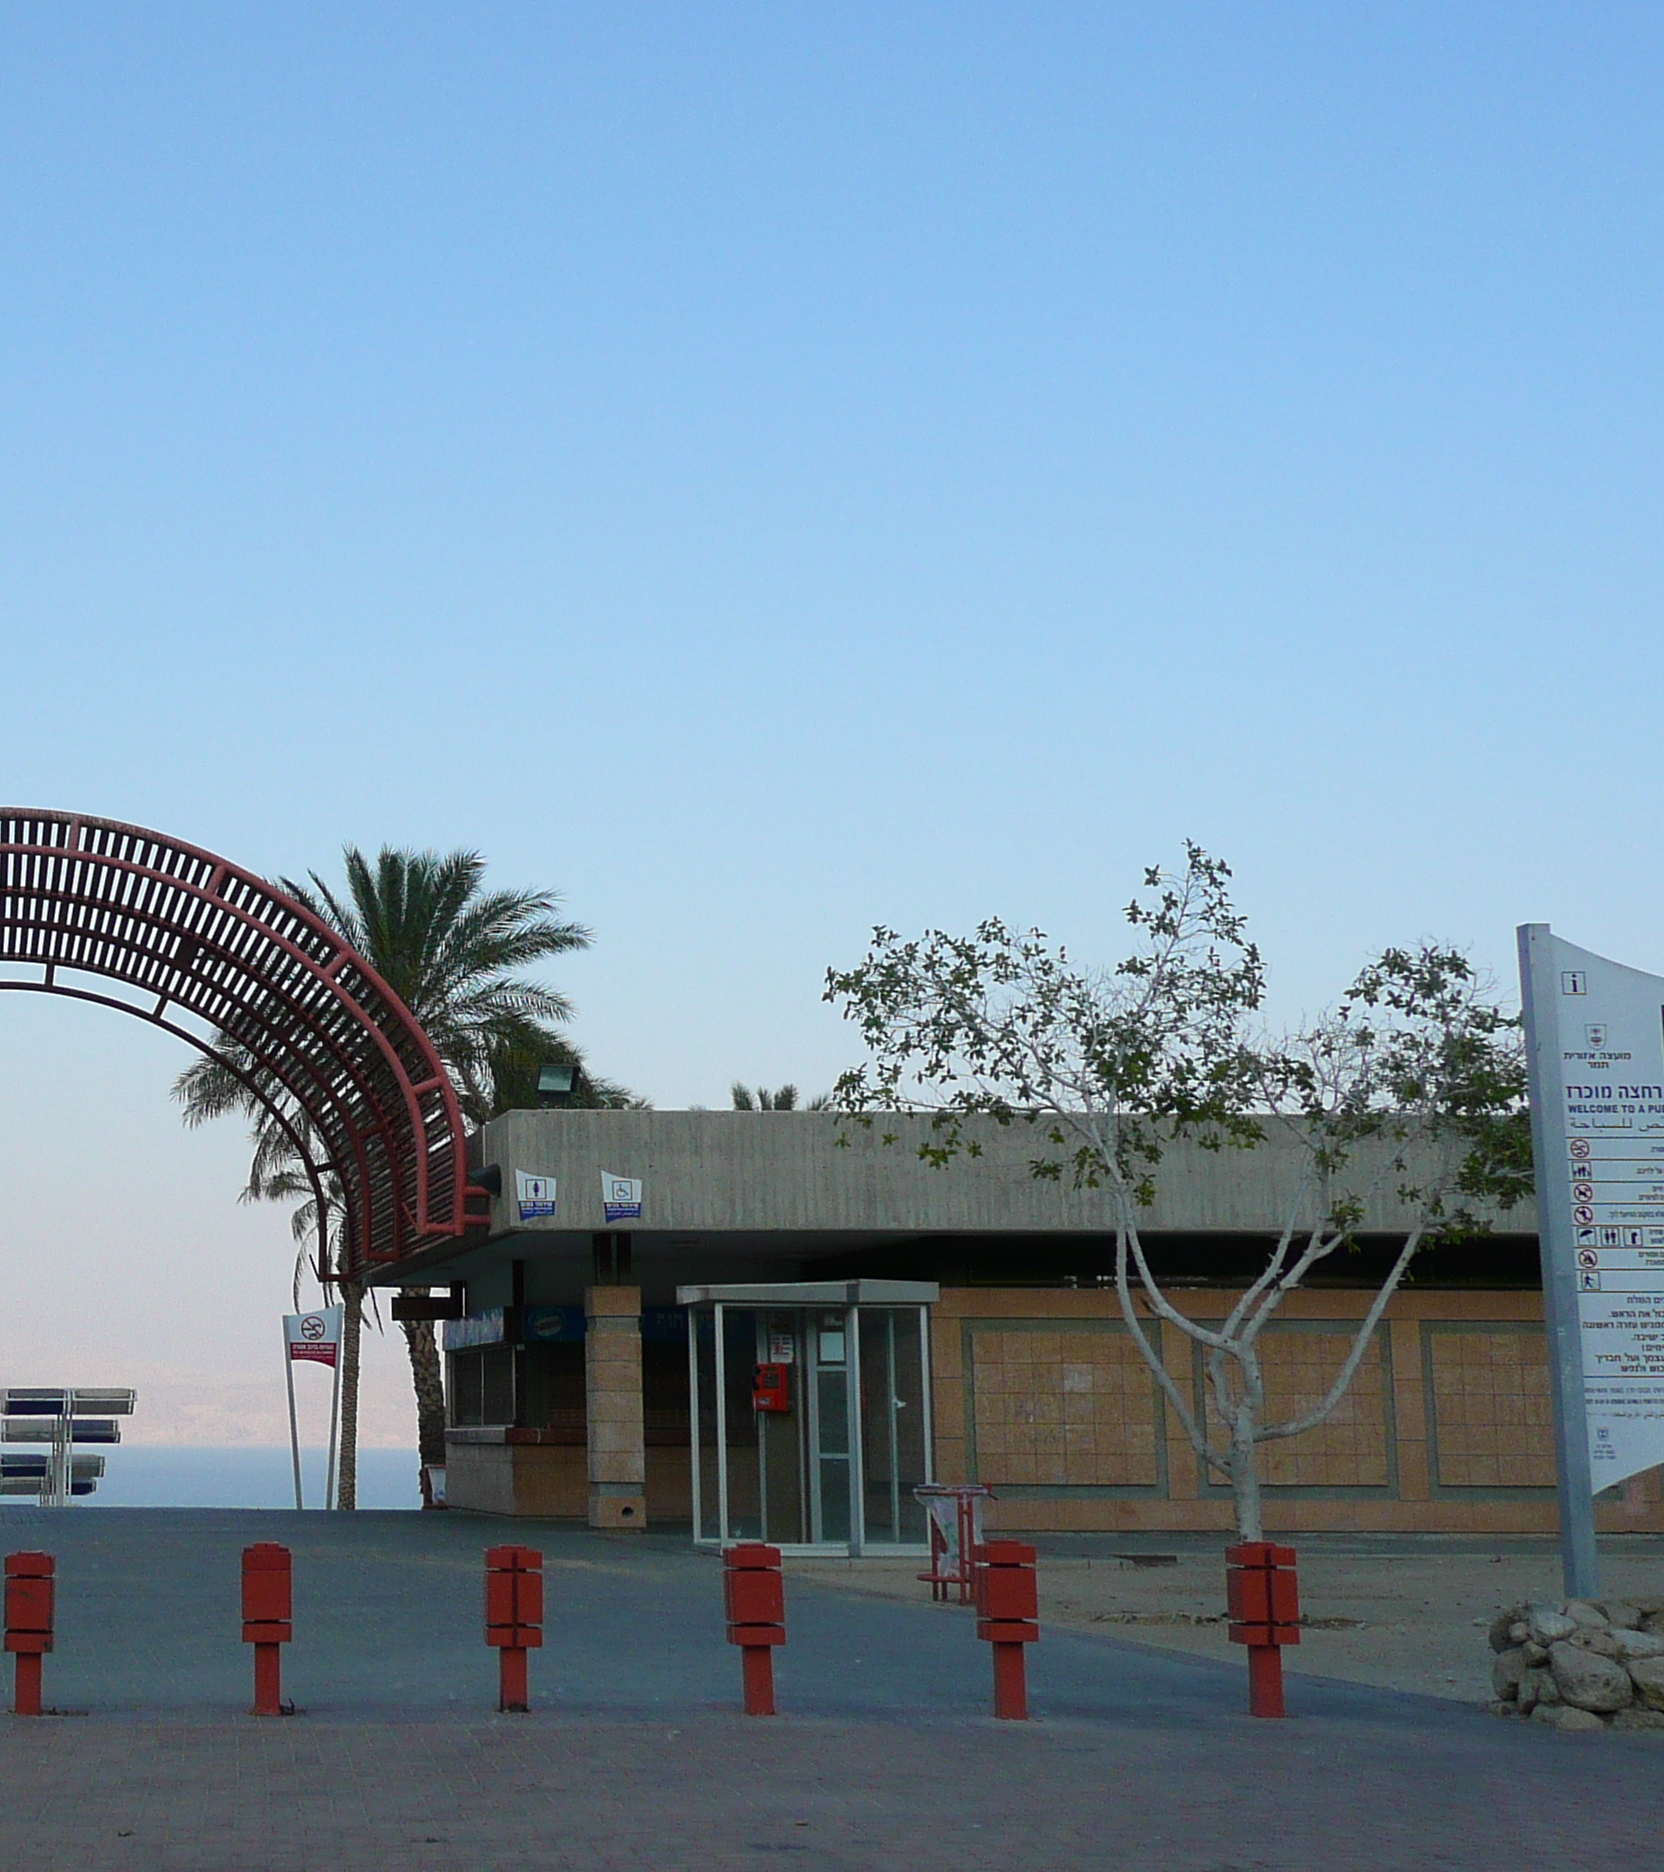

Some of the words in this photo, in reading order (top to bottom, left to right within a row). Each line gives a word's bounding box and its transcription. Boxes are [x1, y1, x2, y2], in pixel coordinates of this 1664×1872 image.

[1565, 1085, 1612, 1099] מוכרז
[1618, 1085, 1663, 1099] רחצה
[1568, 1104, 1618, 1114] WELCOME
[1623, 1104, 1635, 1114] TO
[1638, 1104, 1645, 1114] A
